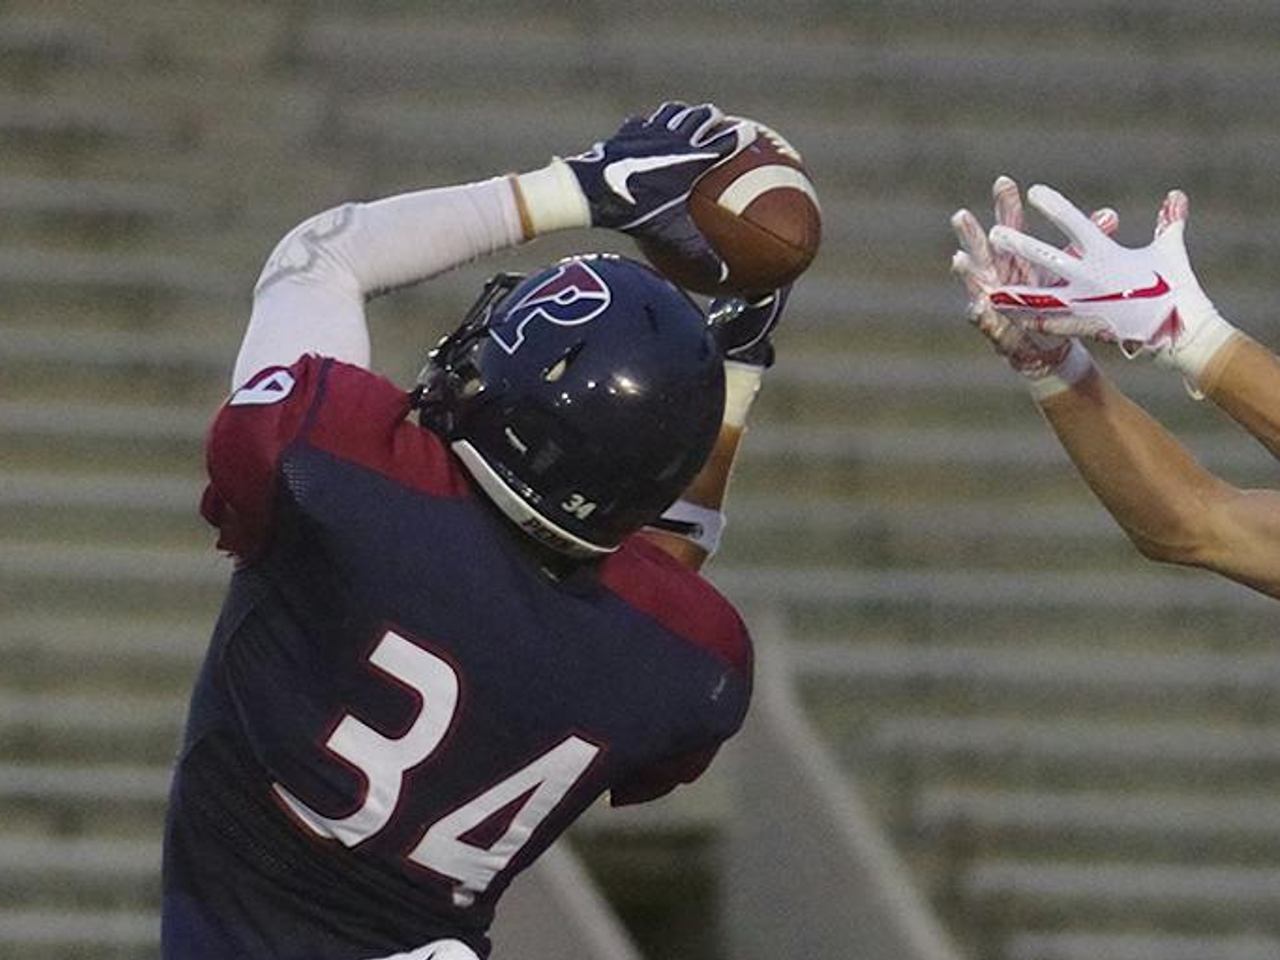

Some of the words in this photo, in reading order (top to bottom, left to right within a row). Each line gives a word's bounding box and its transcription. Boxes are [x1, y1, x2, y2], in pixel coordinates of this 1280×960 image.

[488, 259, 612, 355] P
[560, 492, 597, 520] 34
[270, 628, 610, 908] 34
